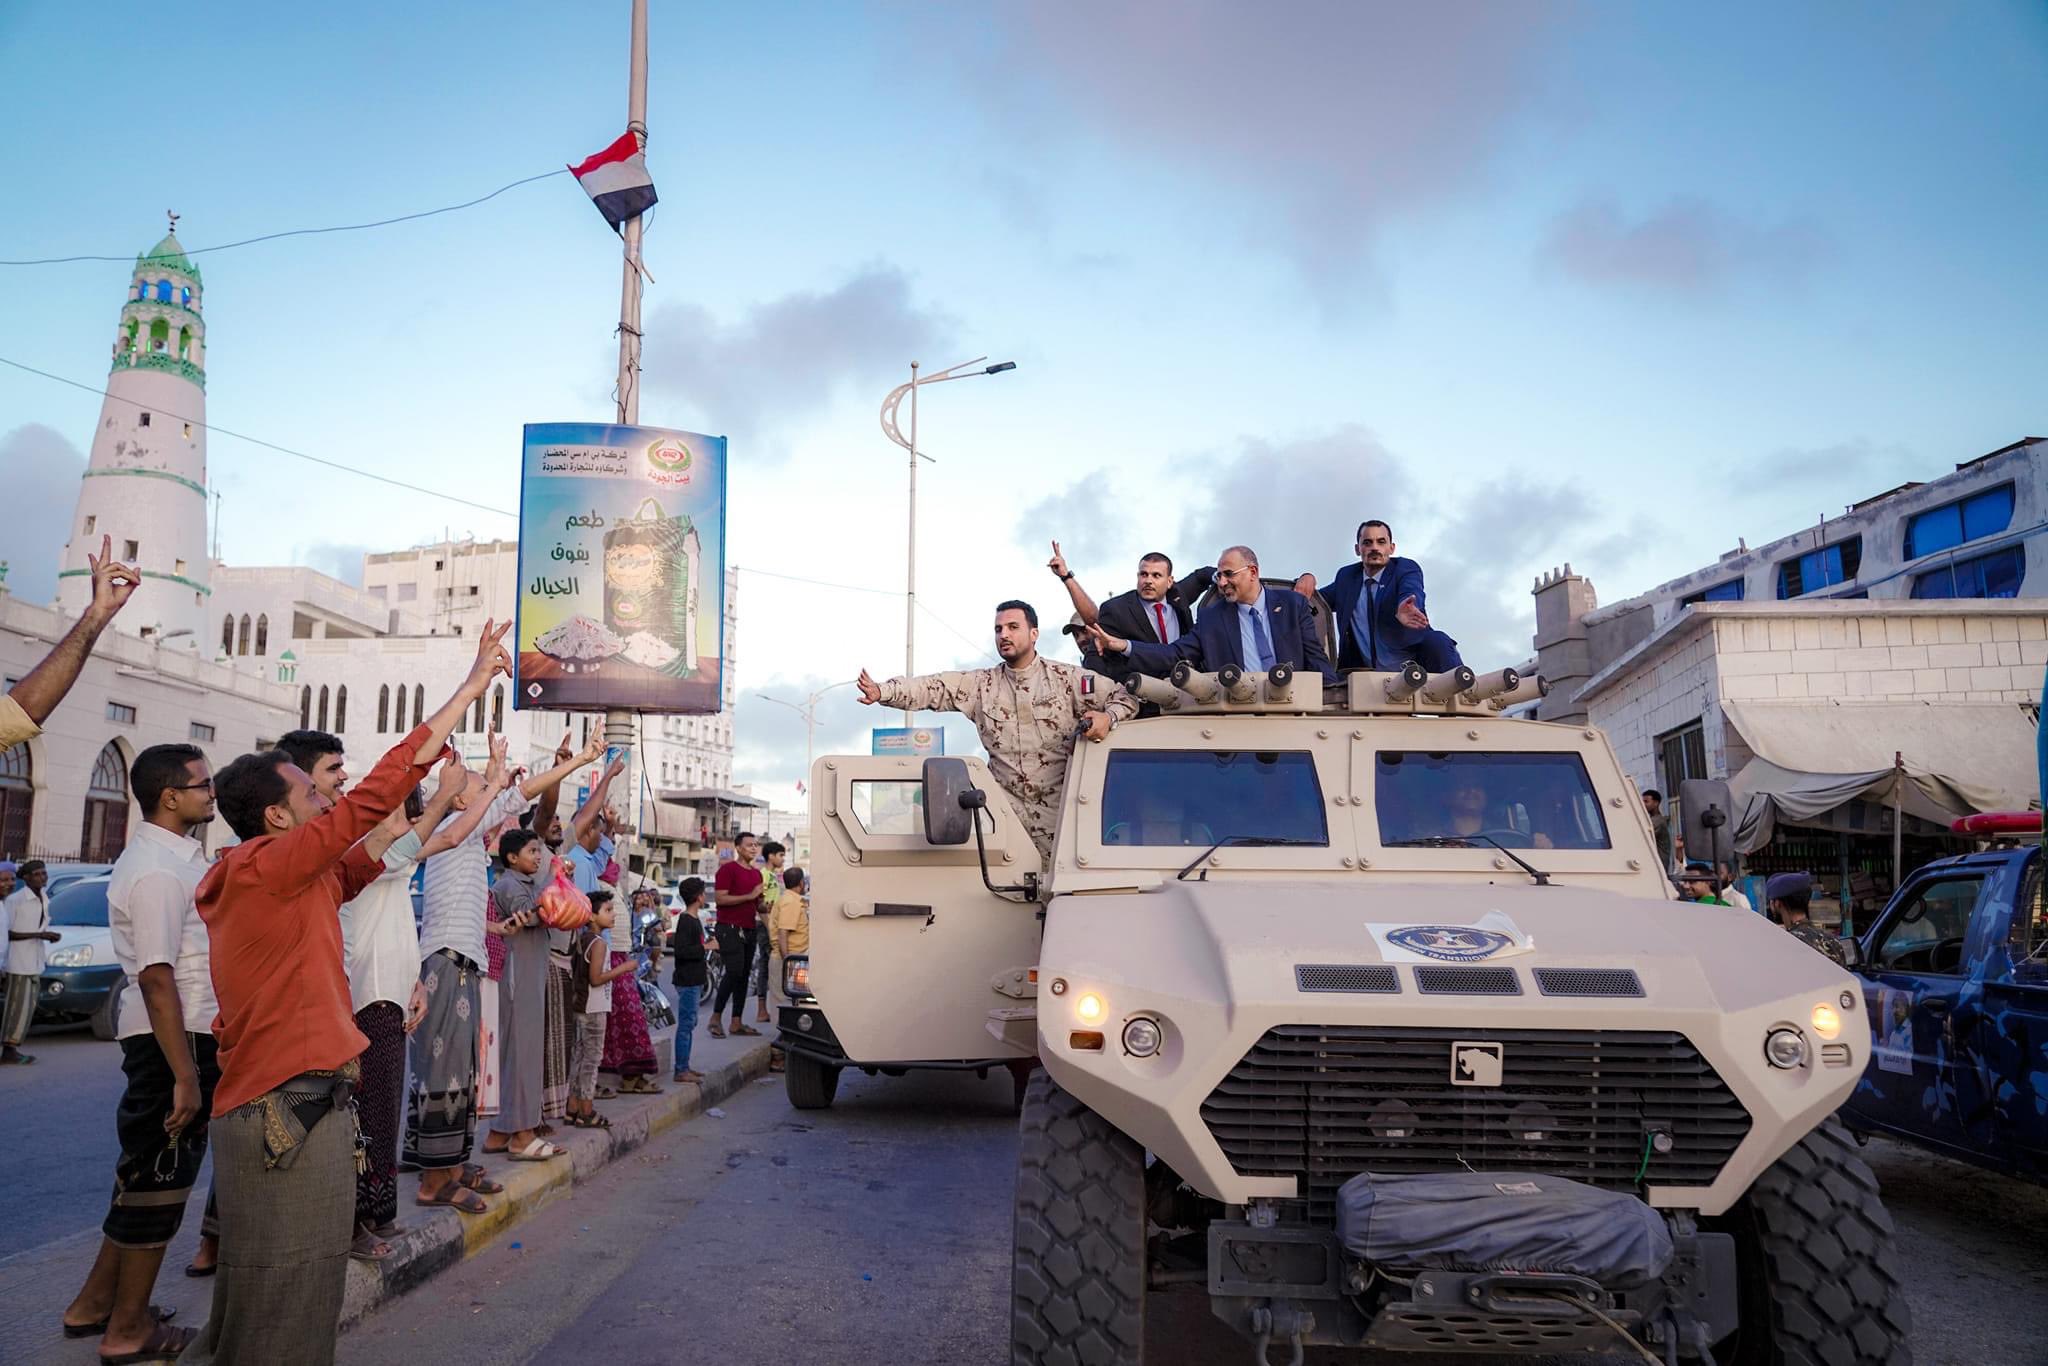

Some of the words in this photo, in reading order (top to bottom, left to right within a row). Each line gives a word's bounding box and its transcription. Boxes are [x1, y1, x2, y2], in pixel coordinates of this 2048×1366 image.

[542, 461, 569, 473] المحدودة
[565, 508, 605, 530] طعم
[551, 542, 590, 565] يفوق
[531, 576, 580, 599] الخيال
